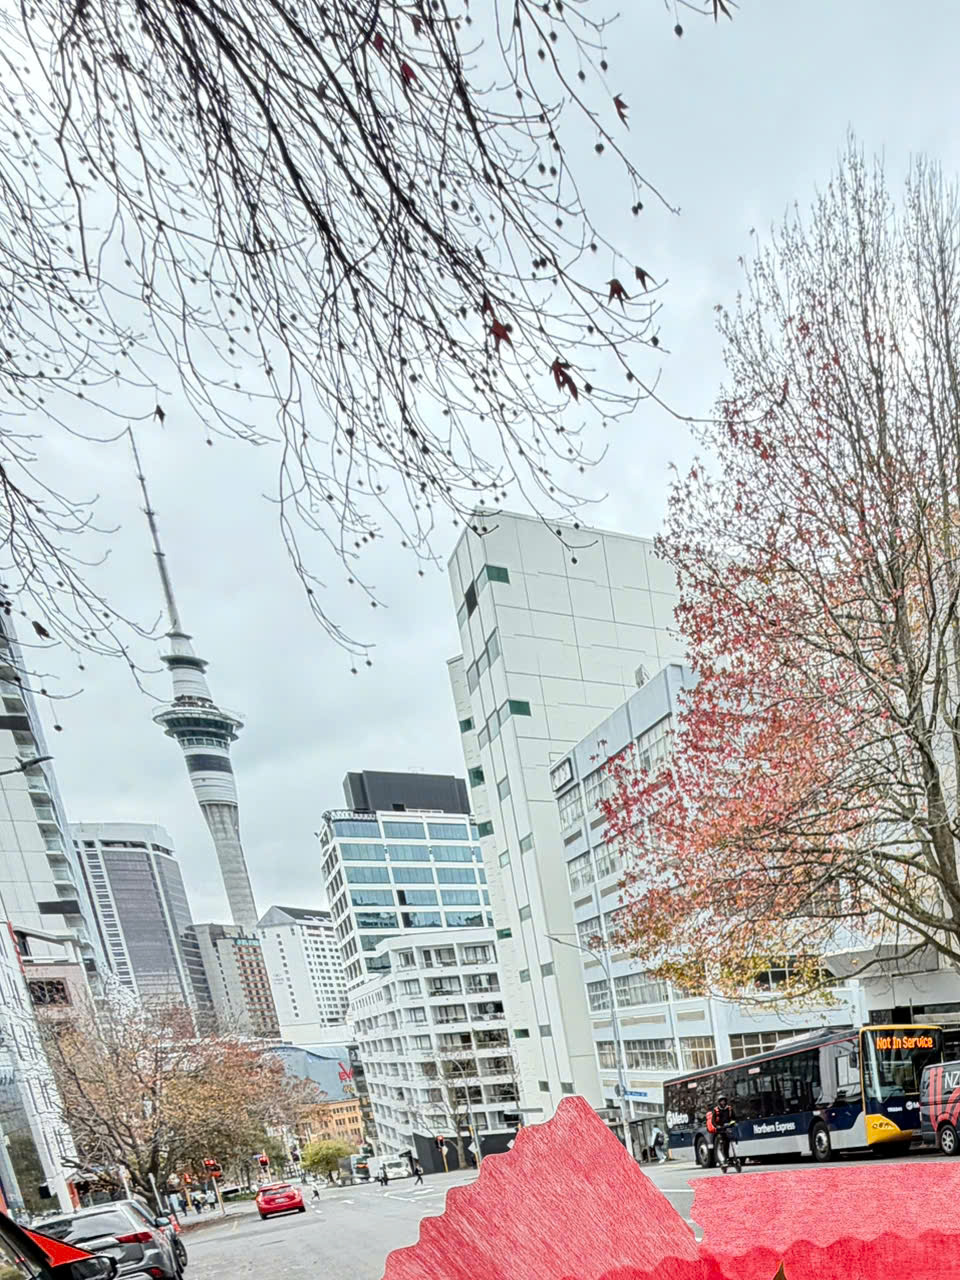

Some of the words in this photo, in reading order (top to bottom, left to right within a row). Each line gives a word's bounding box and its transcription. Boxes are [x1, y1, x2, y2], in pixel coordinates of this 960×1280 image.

[876, 1036, 891, 1049] Not
[893, 1036, 901, 1049] In
[903, 1036, 933, 1049] Service
[753, 1123, 775, 1135] Northern
[776, 1121, 796, 1132] Express
